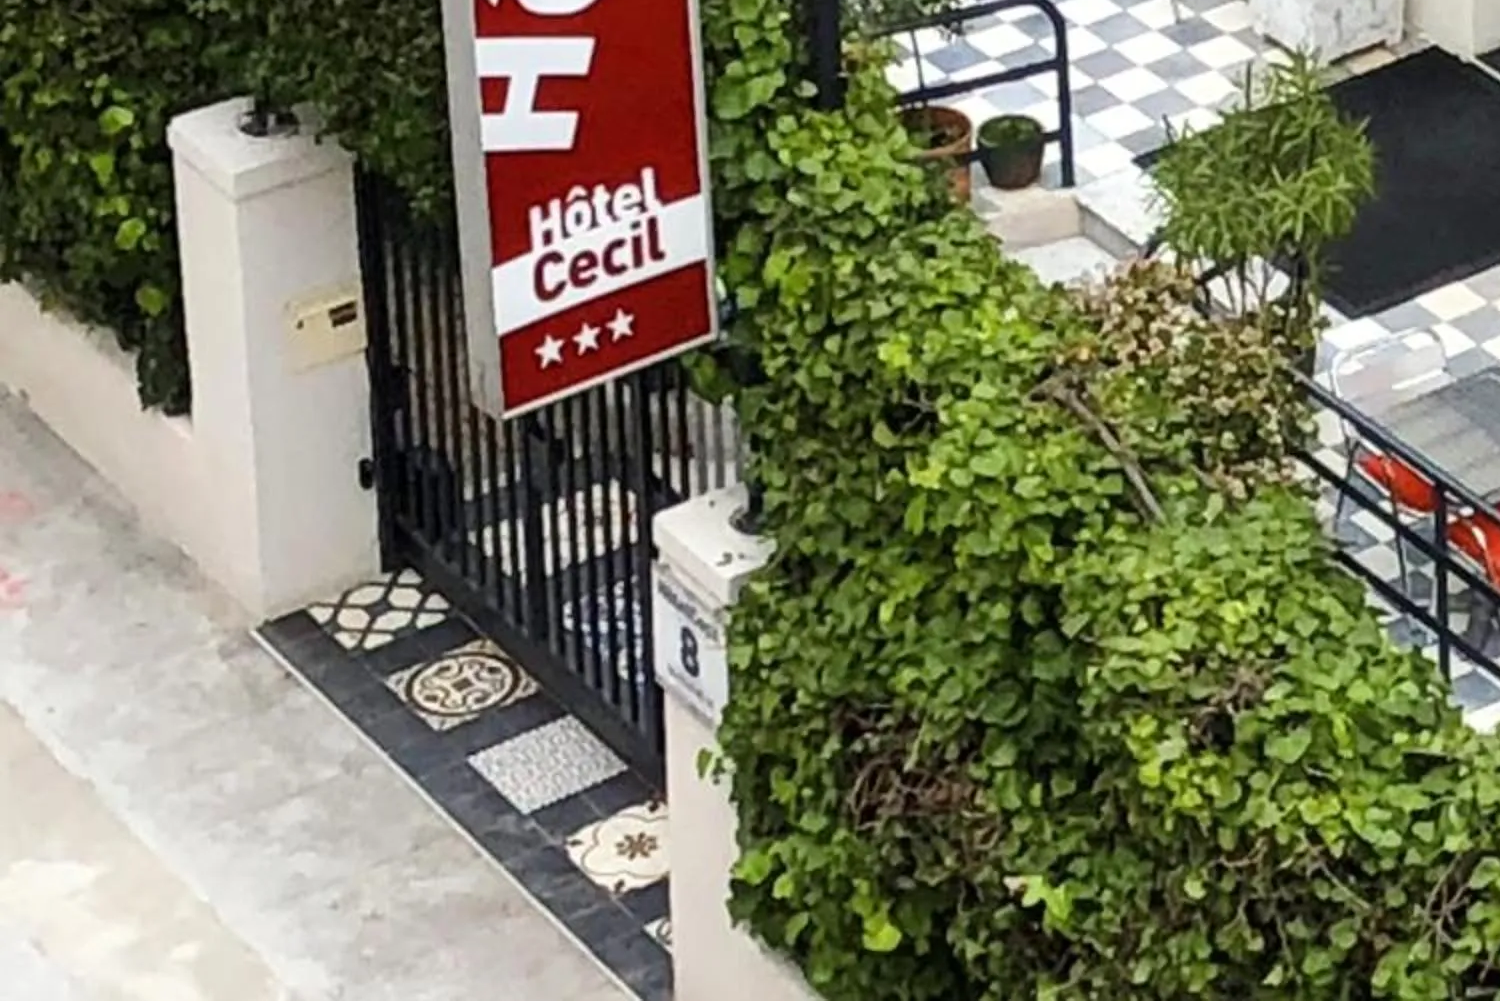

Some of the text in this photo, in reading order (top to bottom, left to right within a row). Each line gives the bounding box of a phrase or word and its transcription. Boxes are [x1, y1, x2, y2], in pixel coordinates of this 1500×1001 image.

[529, 167, 661, 253] Hôtel
[534, 215, 665, 302] Cecil
[680, 626, 700, 677] 8
